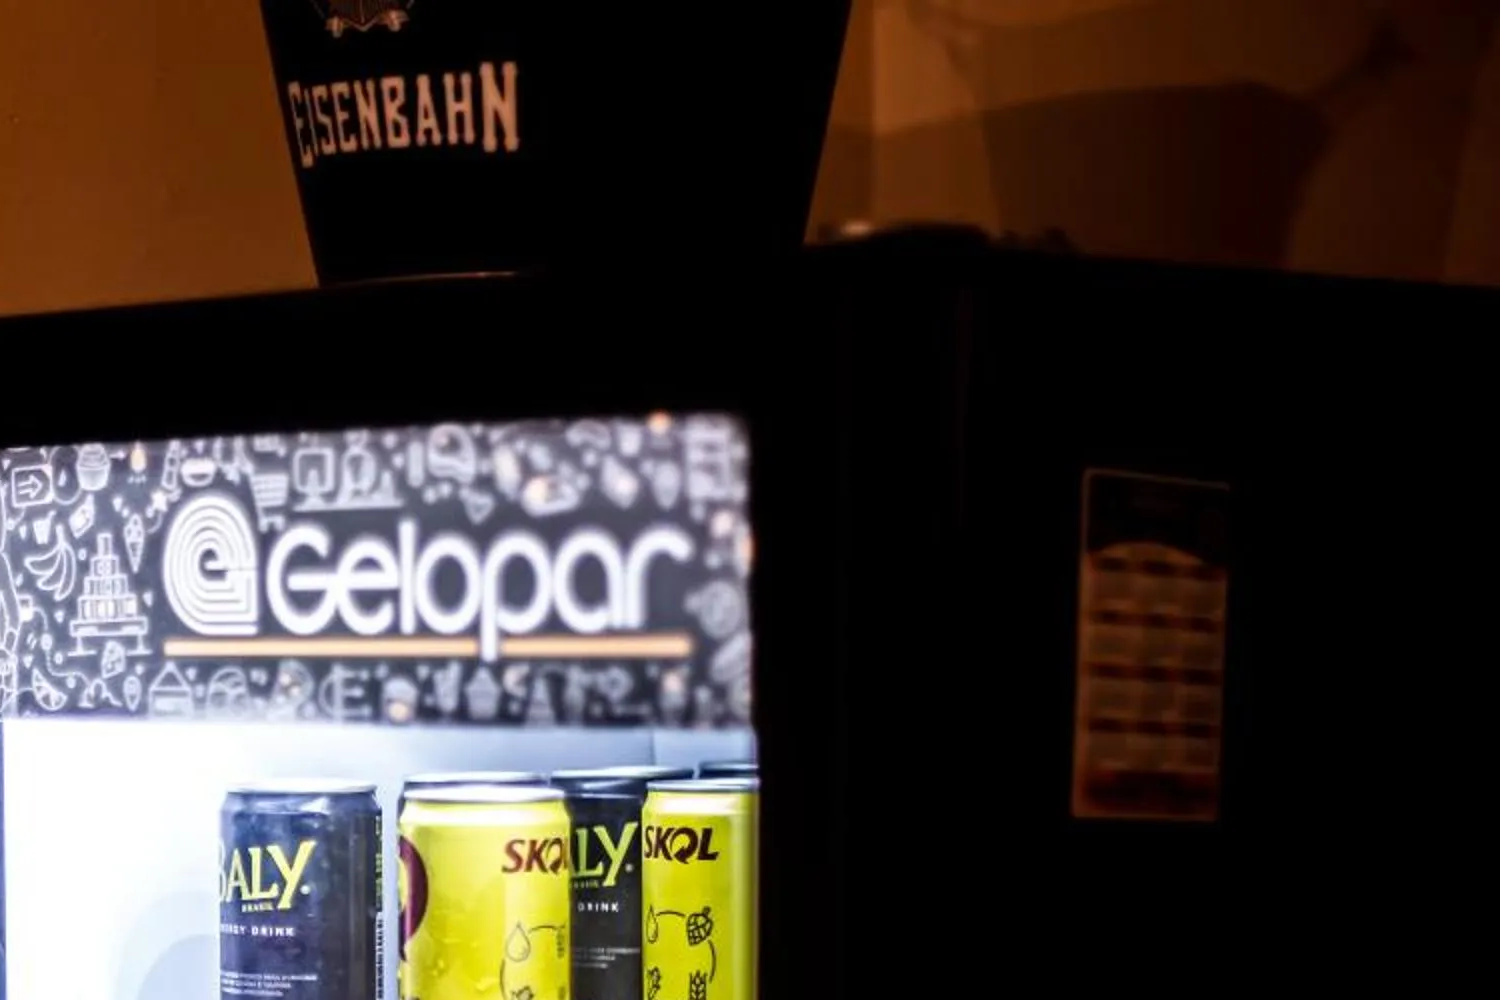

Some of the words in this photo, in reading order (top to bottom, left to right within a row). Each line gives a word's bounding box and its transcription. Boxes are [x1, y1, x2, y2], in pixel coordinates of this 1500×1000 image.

[288, 61, 520, 168] EISENBAHN
[266, 518, 693, 662] Gelopar
[644, 825, 721, 864] SKOL
[578, 901, 619, 912] DRINK
[251, 926, 295, 937] DRINK
